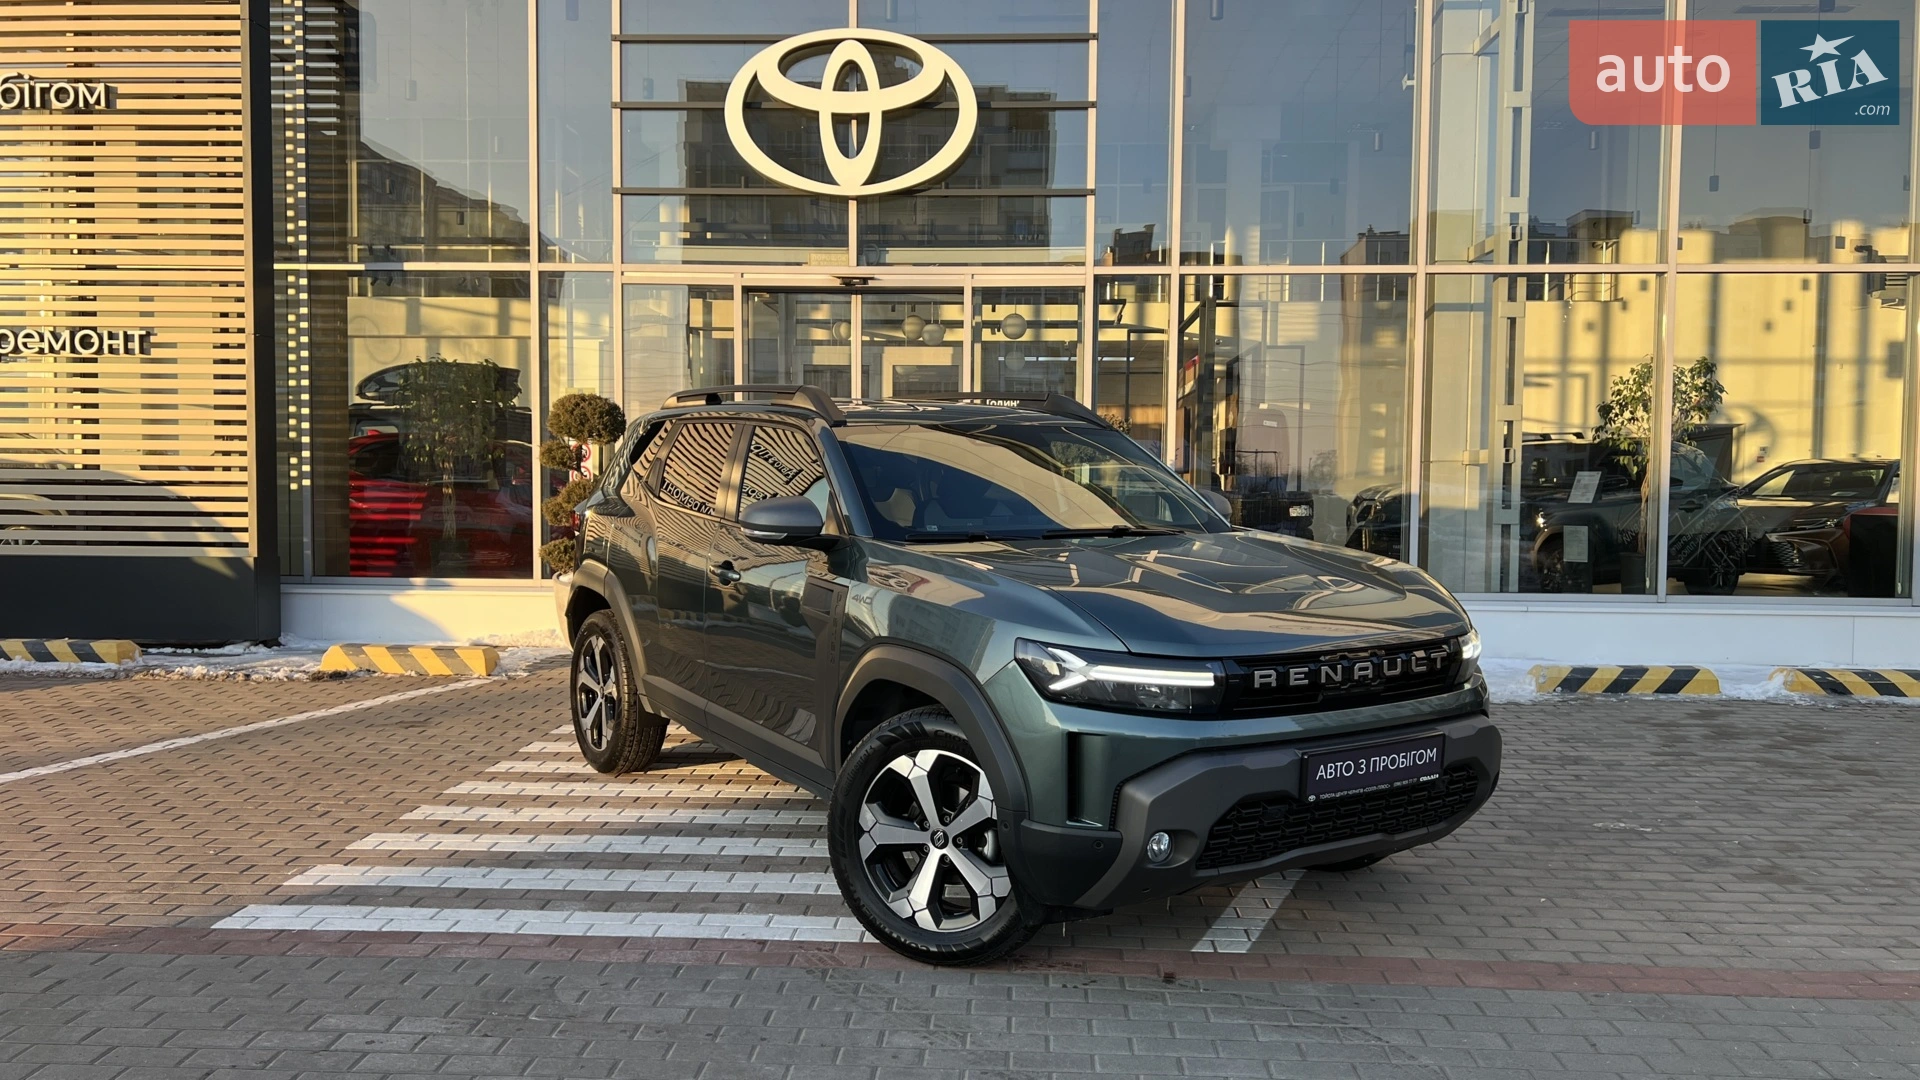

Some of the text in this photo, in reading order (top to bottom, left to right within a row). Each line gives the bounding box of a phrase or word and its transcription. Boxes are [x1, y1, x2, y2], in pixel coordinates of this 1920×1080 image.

[851, 594, 874, 605] 4WD
[1253, 651, 1448, 689] RENAULT
[1315, 760, 1355, 780] АВТО
[1369, 747, 1437, 773] ПРОБІГОМ
